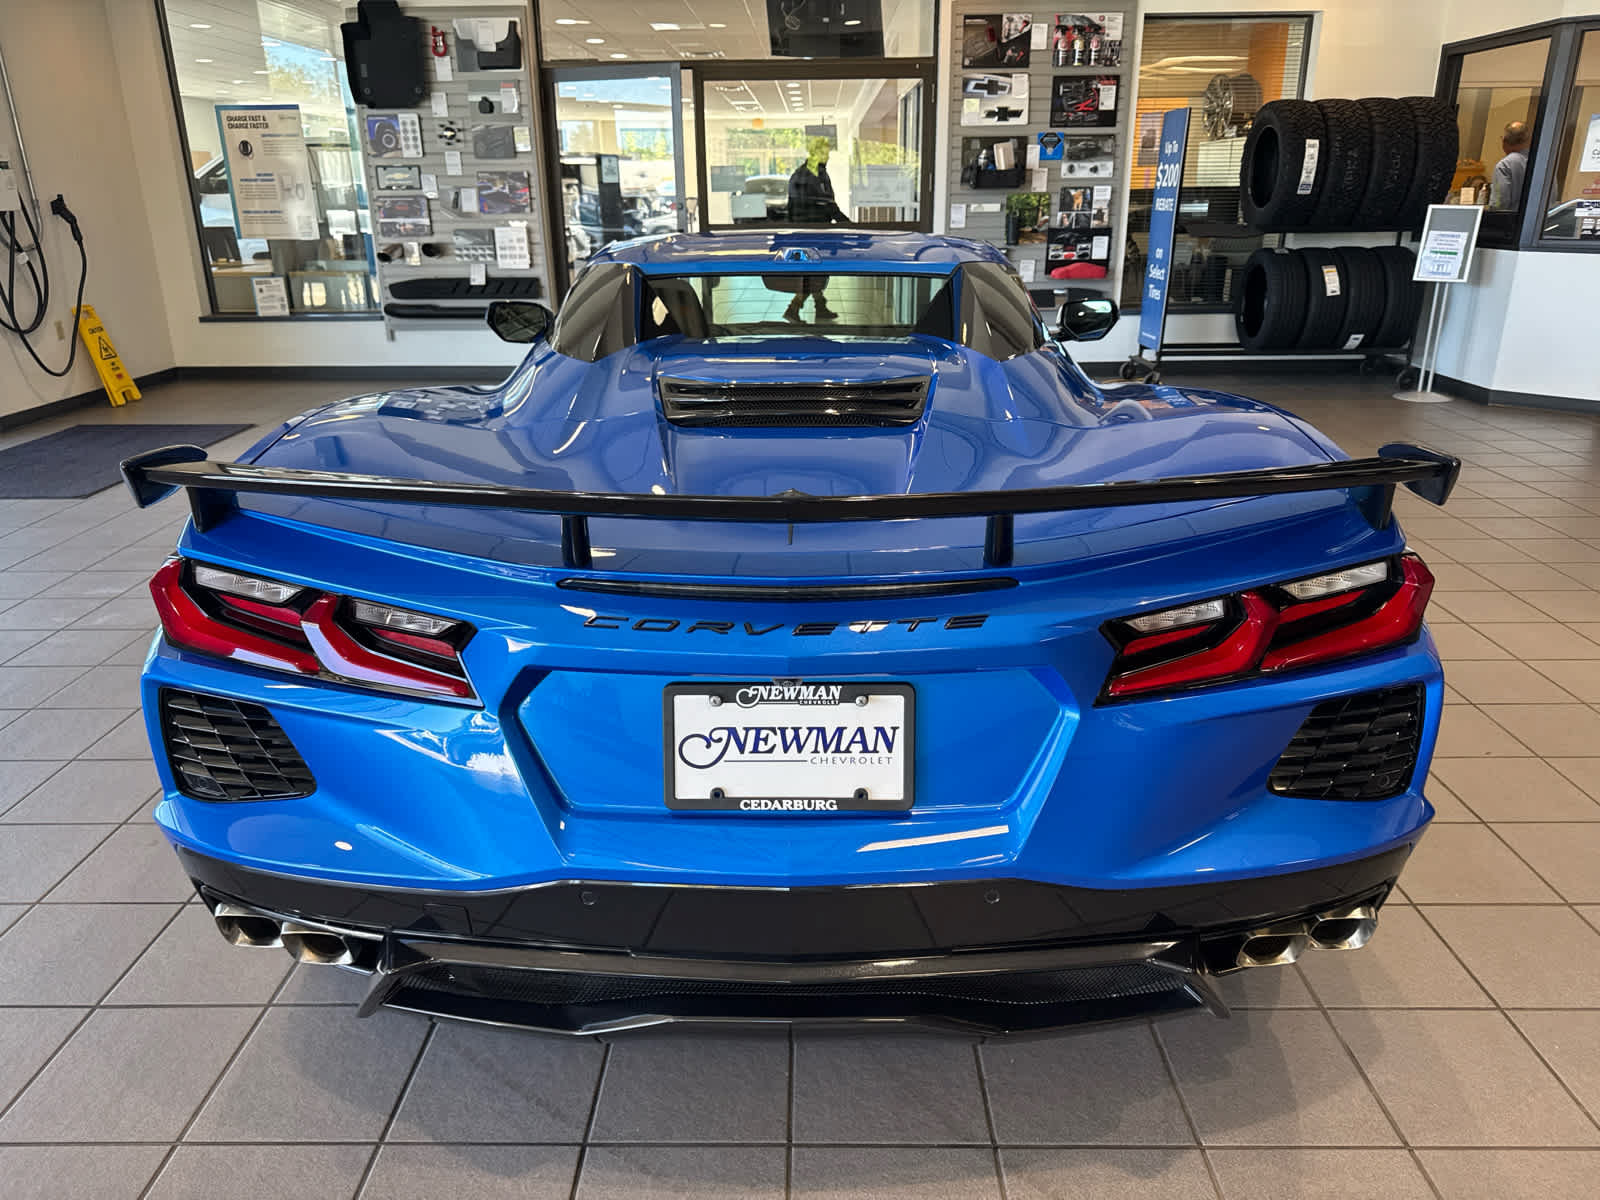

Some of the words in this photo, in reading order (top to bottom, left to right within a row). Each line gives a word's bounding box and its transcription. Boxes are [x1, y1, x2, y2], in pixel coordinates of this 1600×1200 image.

[1164, 141, 1172, 156] Up
[1172, 140, 1179, 153] To
[1156, 162, 1180, 190] $200
[1155, 197, 1175, 212] REBATE
[1148, 263, 1166, 281] Select
[1148, 283, 1161, 301] Tires
[583, 614, 990, 636] CORVETTE
[736, 685, 842, 709] NEWMAN
[678, 726, 900, 769] NEWMAN
[810, 756, 893, 765] CHEVROLET
[739, 799, 838, 811] CEDARBURG
